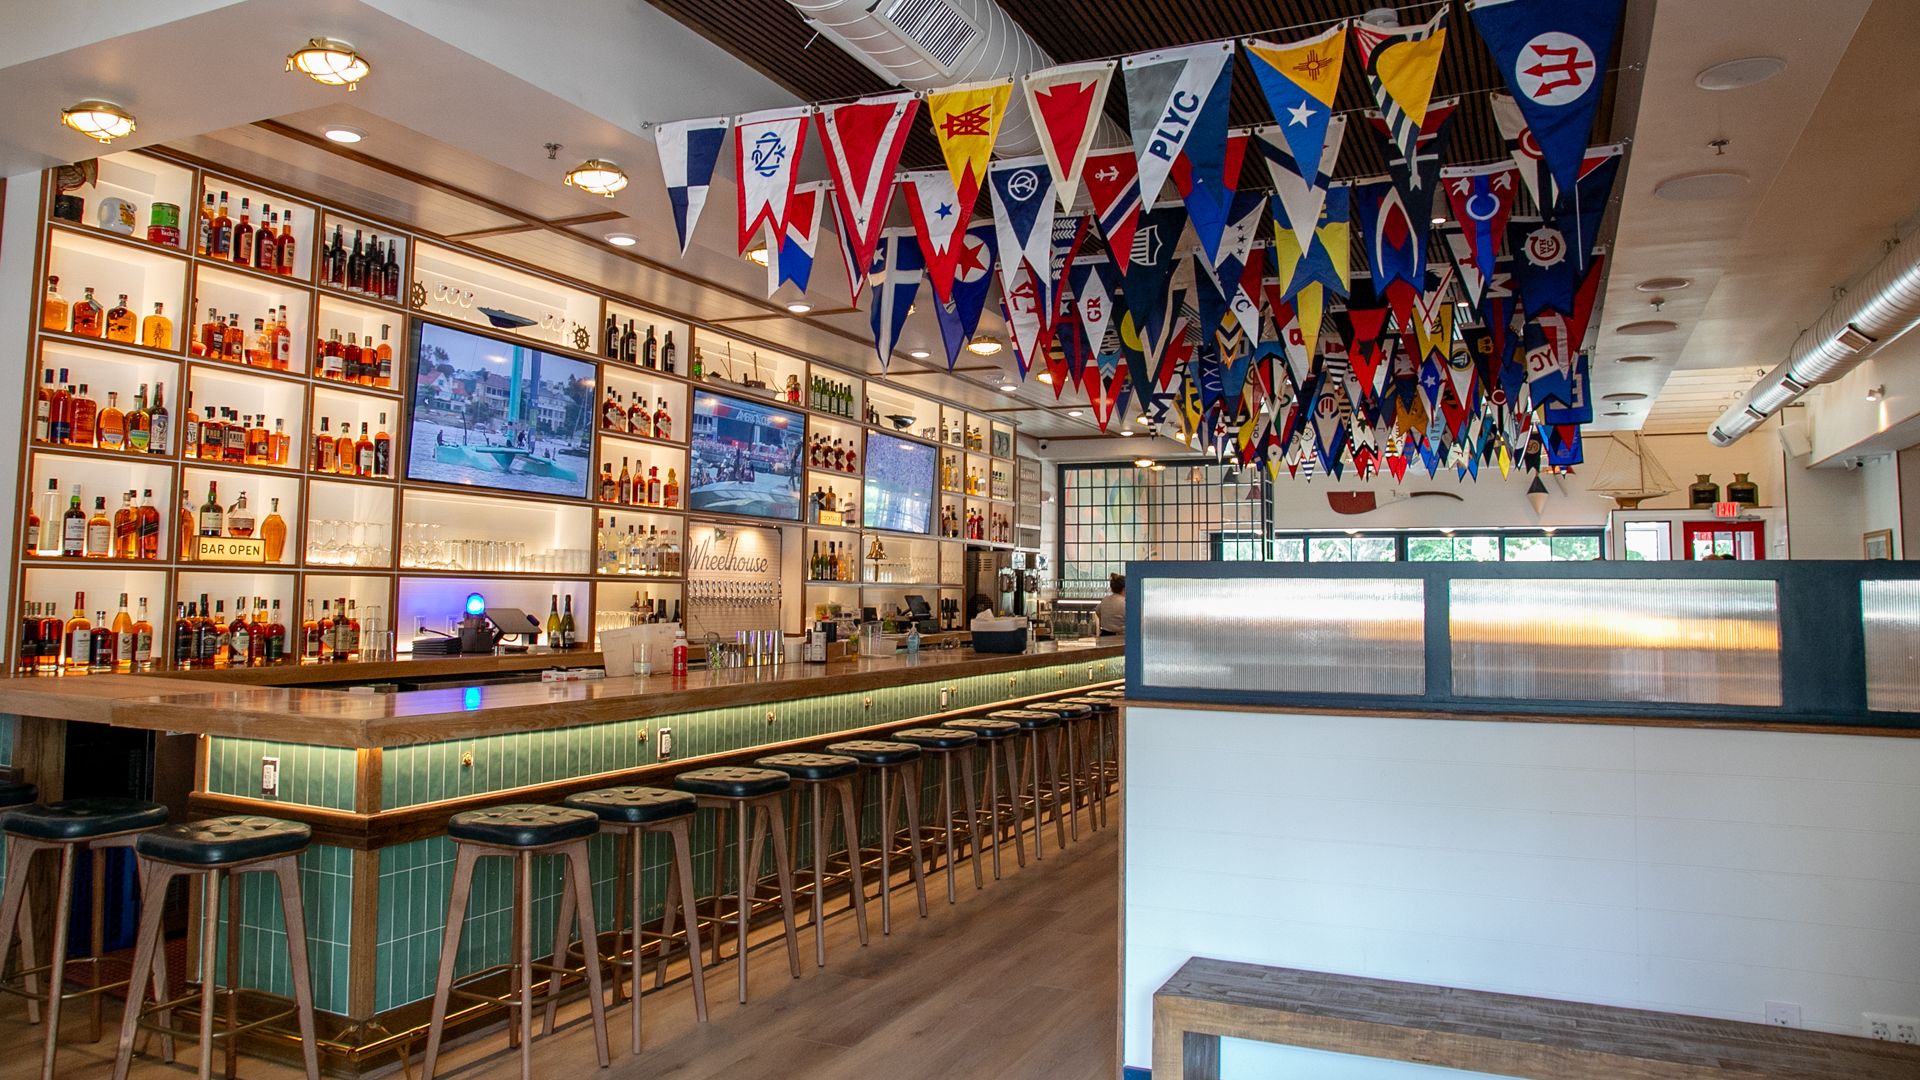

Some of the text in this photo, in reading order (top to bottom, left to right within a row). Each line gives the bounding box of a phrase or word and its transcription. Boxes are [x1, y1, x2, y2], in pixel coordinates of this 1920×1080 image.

[1148, 90, 1200, 162] PLYC
[1086, 296, 1102, 323] GR
[1718, 502, 1737, 517] EXIT
[201, 543, 260, 556] BAR OPEN
[688, 535, 769, 573] Wheelhouse
